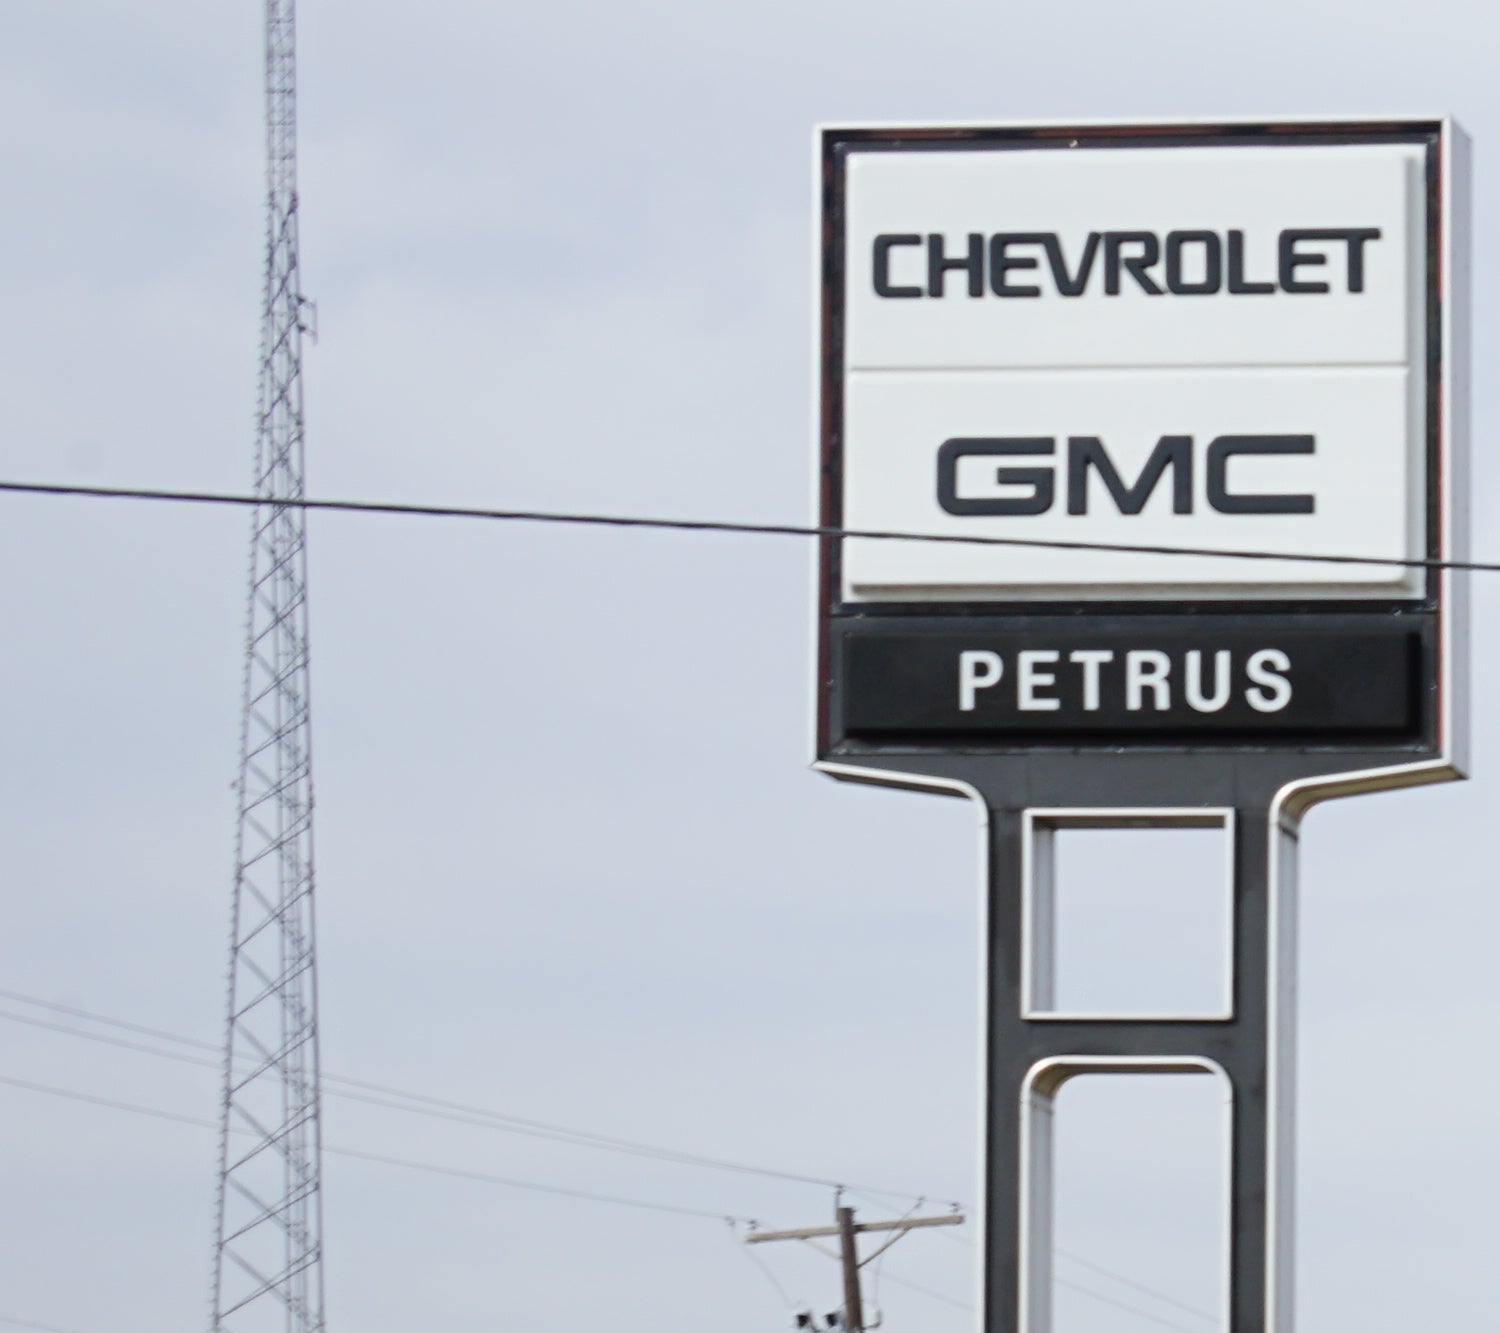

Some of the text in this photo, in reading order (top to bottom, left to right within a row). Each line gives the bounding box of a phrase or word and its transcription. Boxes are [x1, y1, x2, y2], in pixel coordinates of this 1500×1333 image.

[872, 227, 1382, 299] CHEVROLET
[936, 433, 1316, 516] GMC
[957, 648, 1293, 712] PETRUS
